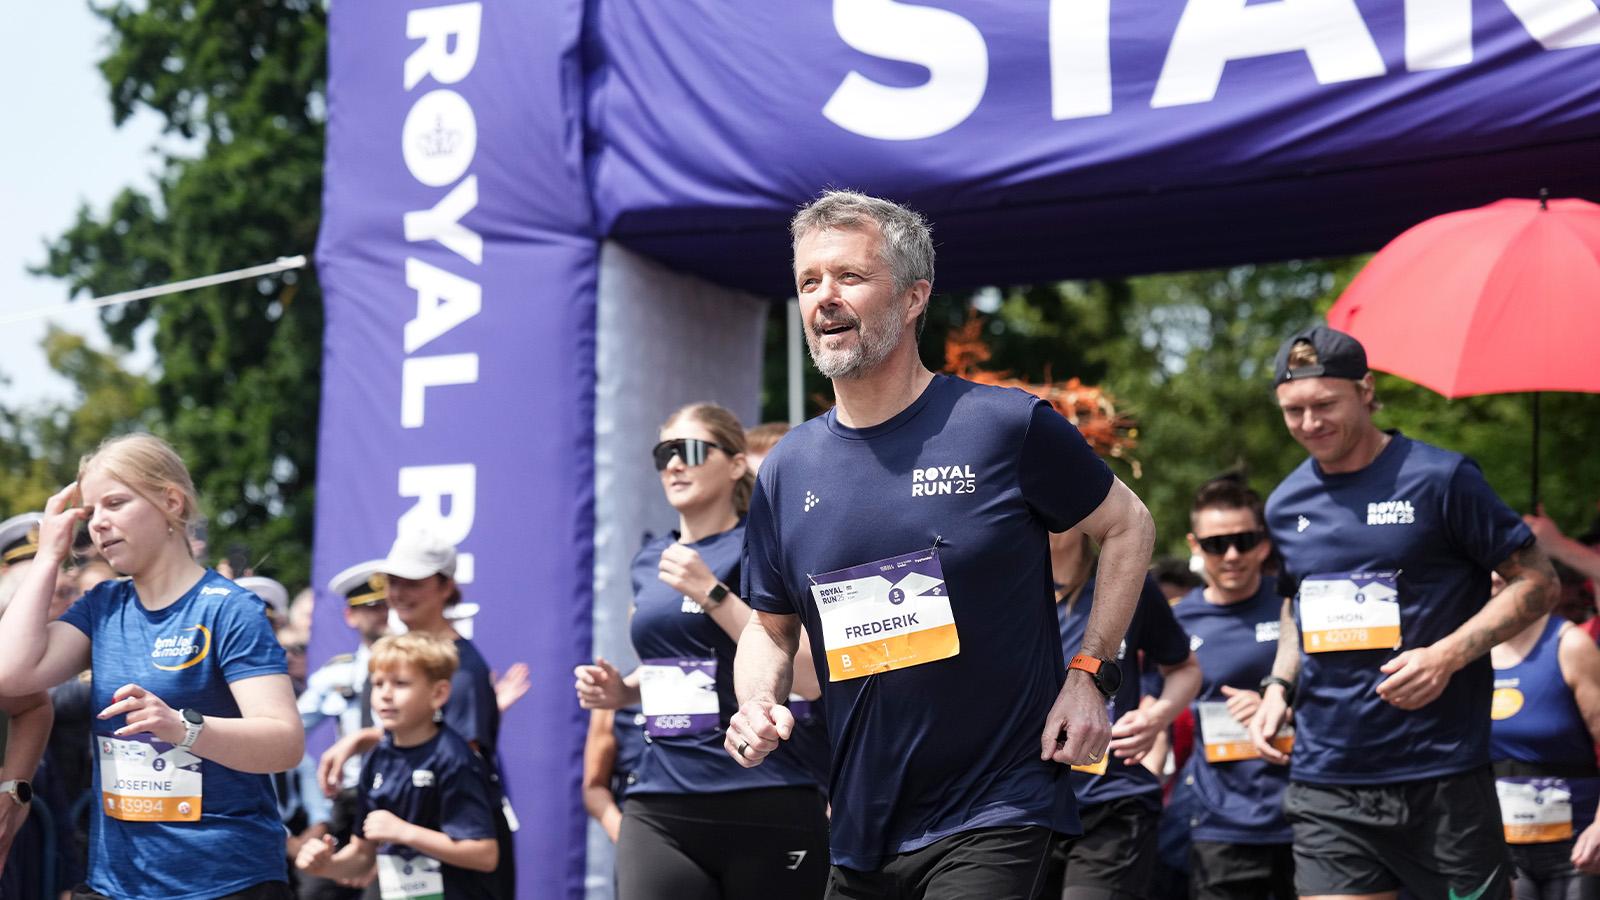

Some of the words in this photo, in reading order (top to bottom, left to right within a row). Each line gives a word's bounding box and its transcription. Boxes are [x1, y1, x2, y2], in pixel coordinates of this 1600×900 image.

[402, 1, 483, 428] ROYAL
[913, 465, 976, 483] ROYAL
[1368, 500, 1415, 514] ROYAL
[819, 586, 843, 597] ROYAL
[845, 612, 920, 640] FREDERIK
[882, 642, 889, 657] 1
[841, 654, 852, 668] B
[114, 779, 172, 791] JOSEFINE
